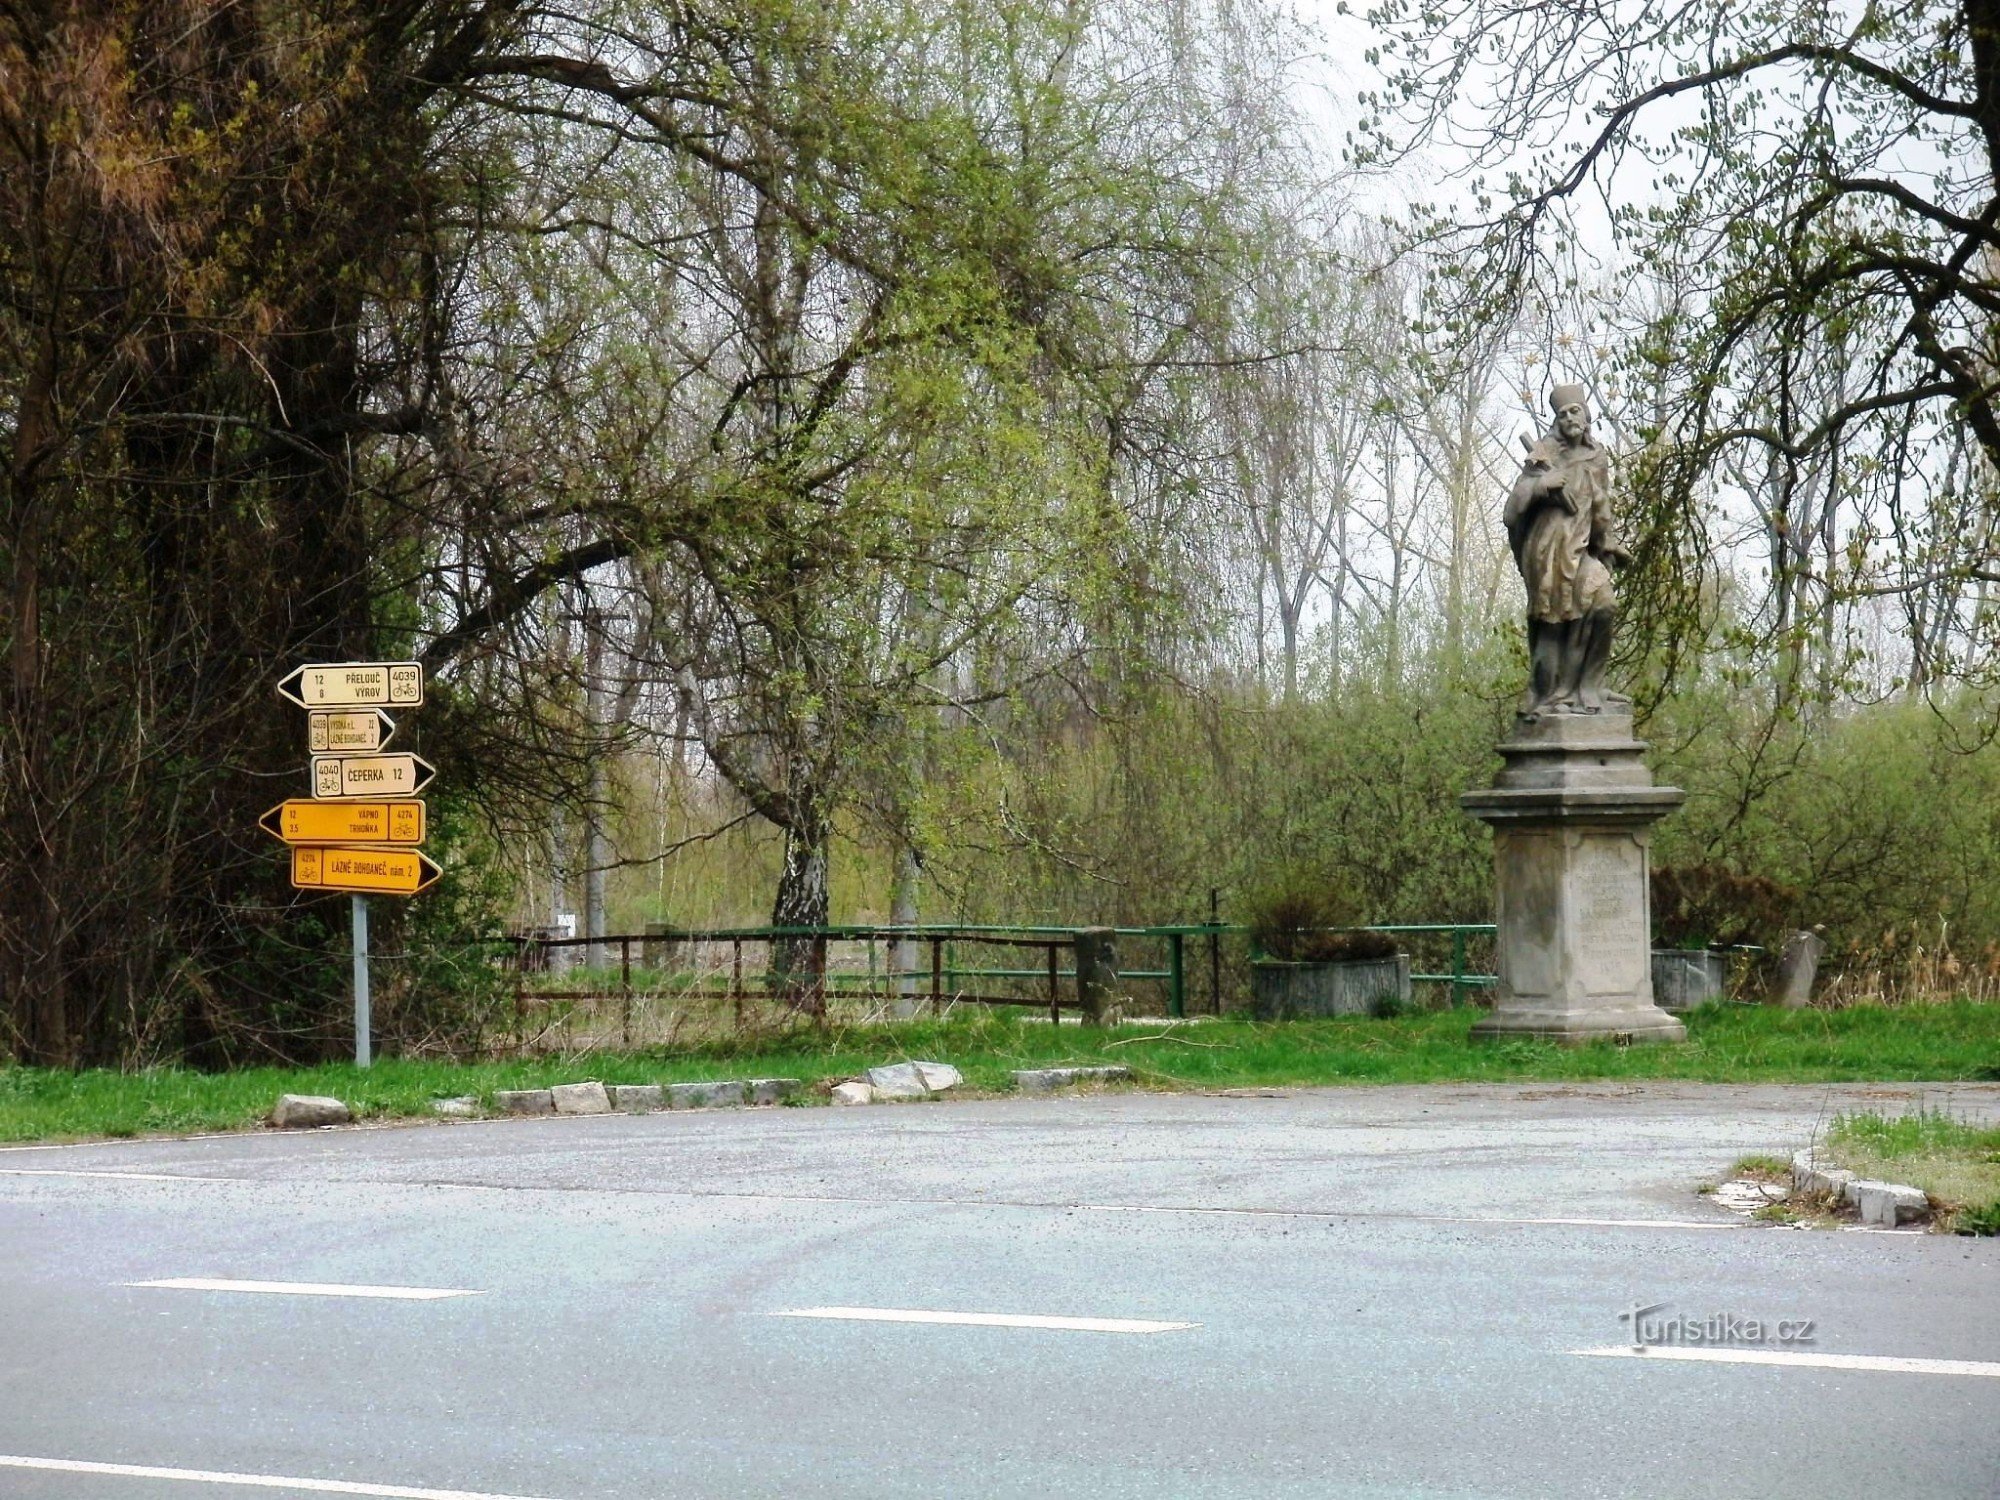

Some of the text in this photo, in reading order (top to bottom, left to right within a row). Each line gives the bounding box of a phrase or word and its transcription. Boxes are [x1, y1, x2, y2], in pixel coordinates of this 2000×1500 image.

[315, 671, 381, 685] 12 PŘELOUČ
[392, 671, 416, 681] 4039
[318, 765, 339, 775] 4040
[348, 768, 403, 782] ČEPERKA 12
[290, 809, 379, 819] 12 VÁPNO
[397, 810, 413, 819] 4274
[331, 858, 351, 873] LÁZNĚ
[407, 866, 413, 877] 2
